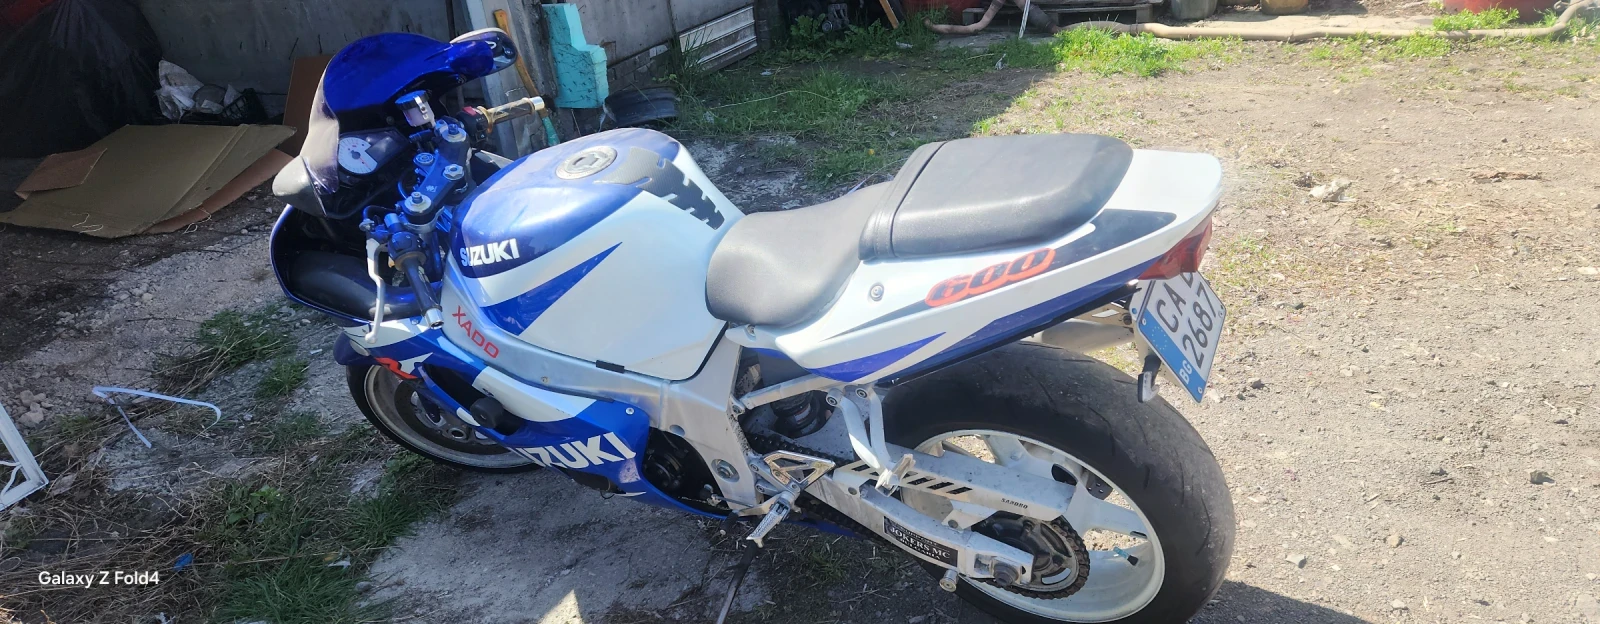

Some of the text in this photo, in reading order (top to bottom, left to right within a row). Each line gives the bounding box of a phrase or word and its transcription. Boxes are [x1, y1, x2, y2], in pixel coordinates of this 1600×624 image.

[460, 238, 520, 267] SUZUKI
[925, 248, 1056, 307] 600
[452, 305, 499, 359] XADO
[1157, 282, 1186, 333] CA
[1182, 282, 1216, 369] 2687
[1179, 360, 1193, 385] BG
[890, 527, 930, 552] JOKERS
[932, 548, 950, 559] MC
